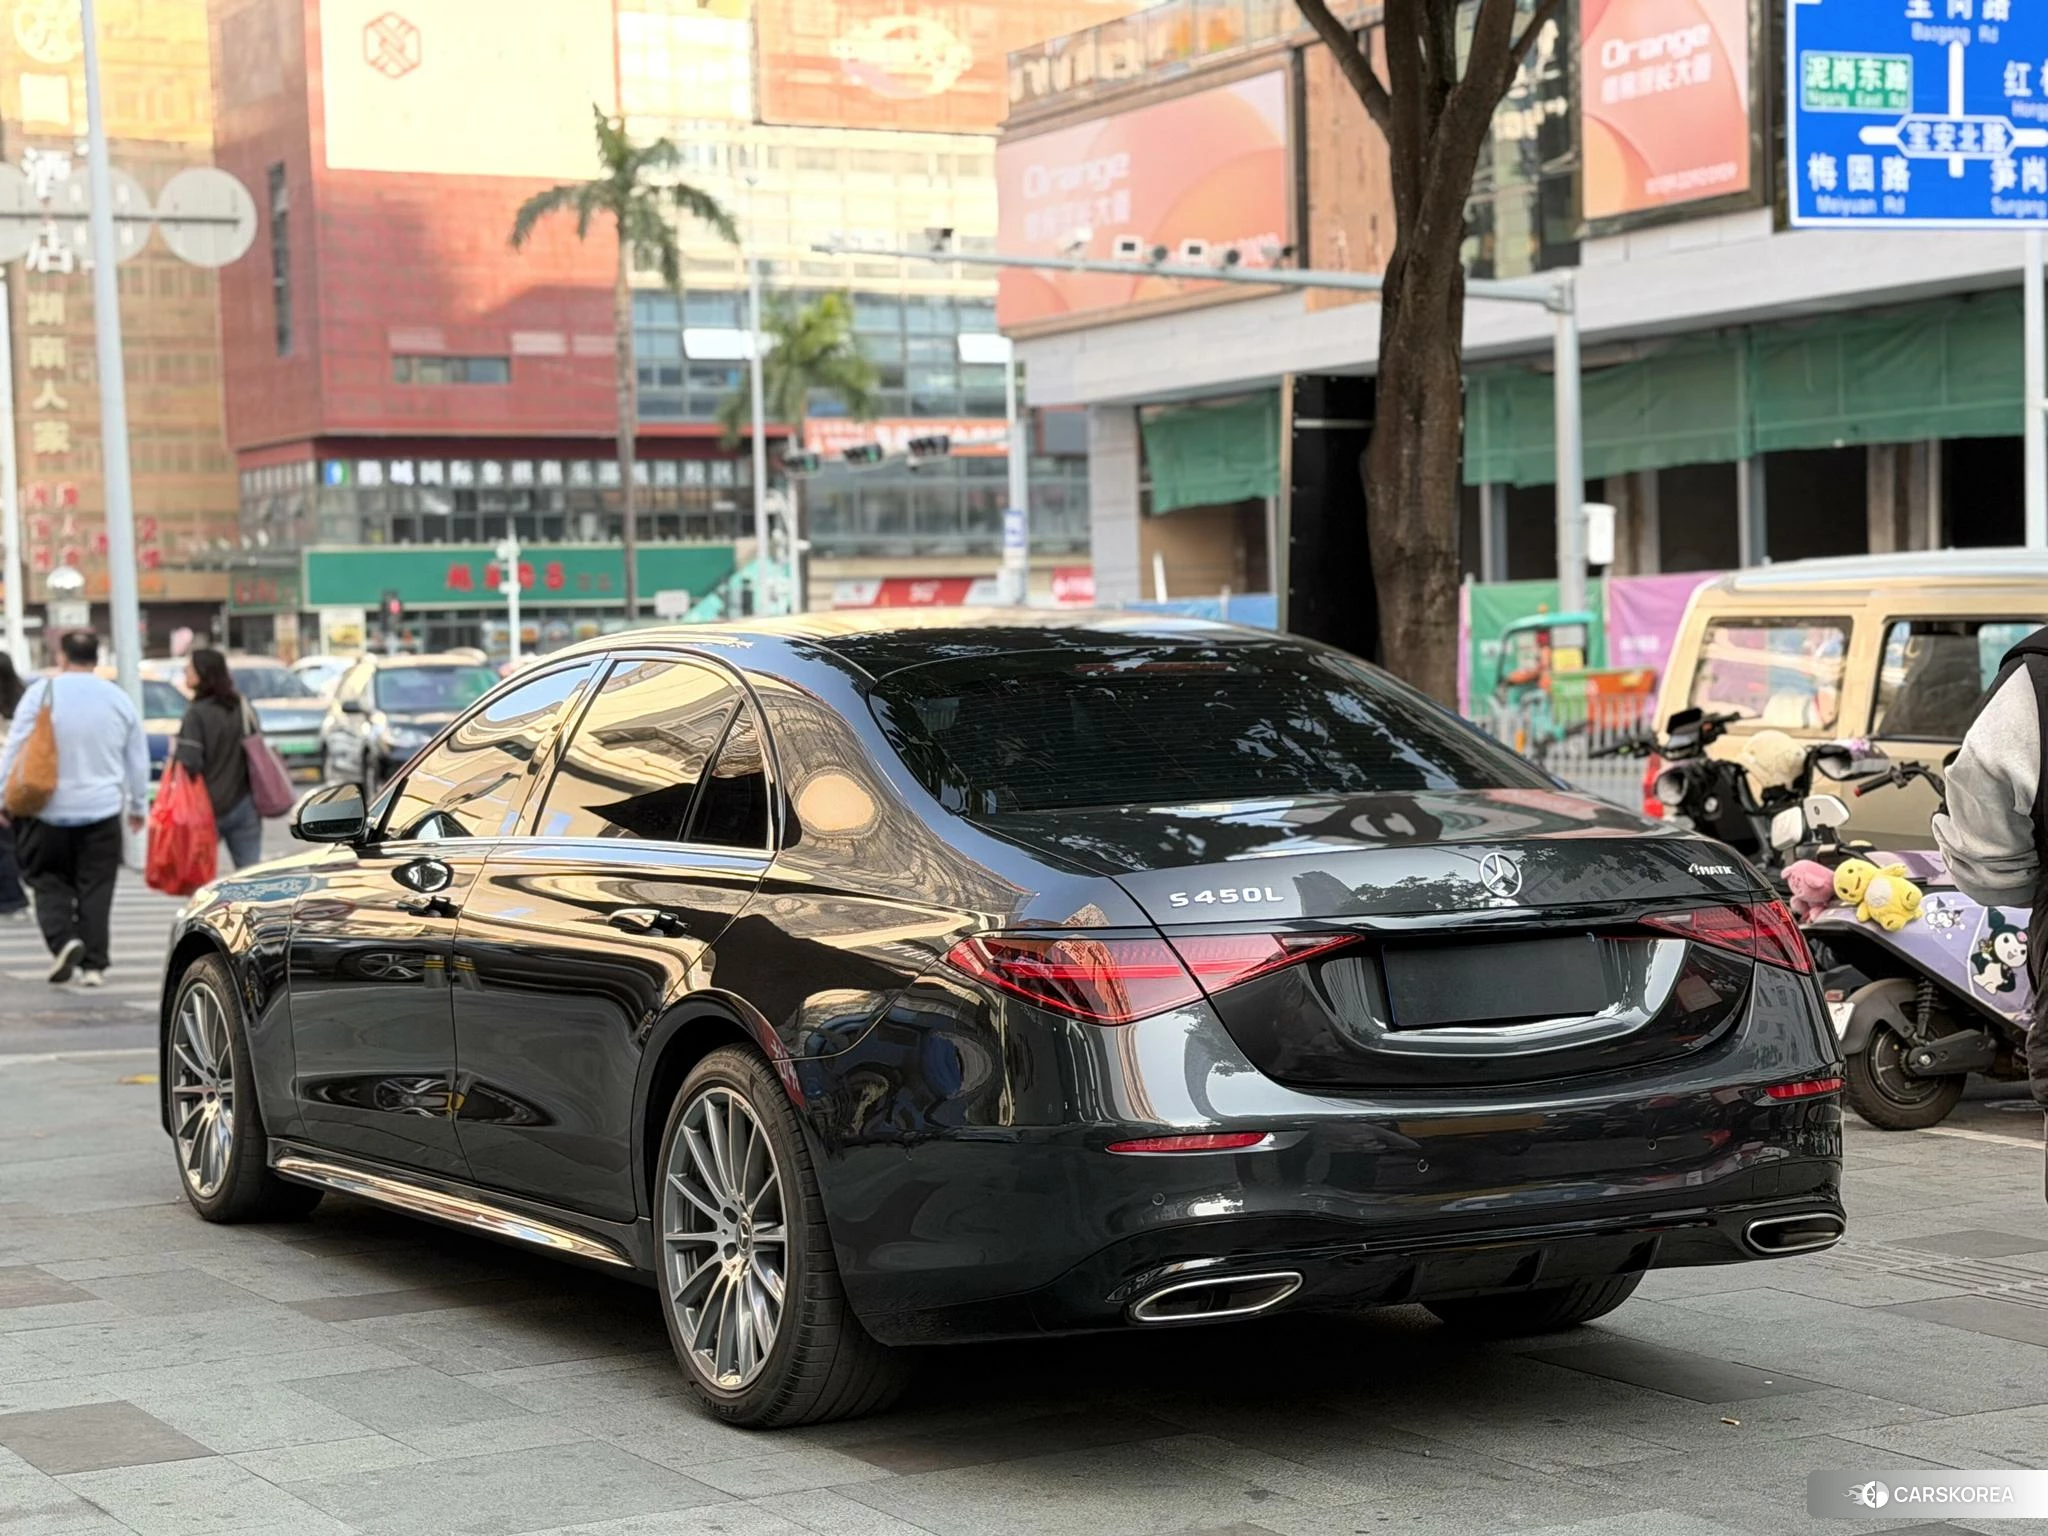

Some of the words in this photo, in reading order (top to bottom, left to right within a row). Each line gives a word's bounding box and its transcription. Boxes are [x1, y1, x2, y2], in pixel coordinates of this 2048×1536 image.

[1601, 23, 1712, 70] Orange
[1978, 24, 2000, 44] Rd
[1906, 122, 2008, 152] 宝安北路
[1023, 151, 1131, 199] Orange
[1808, 152, 1911, 193] 梅园路
[22, 147, 74, 273] 酒店
[1883, 195, 1906, 214] Rd
[27, 291, 71, 454] 湖南人家
[1688, 862, 1735, 876] 4MATIC
